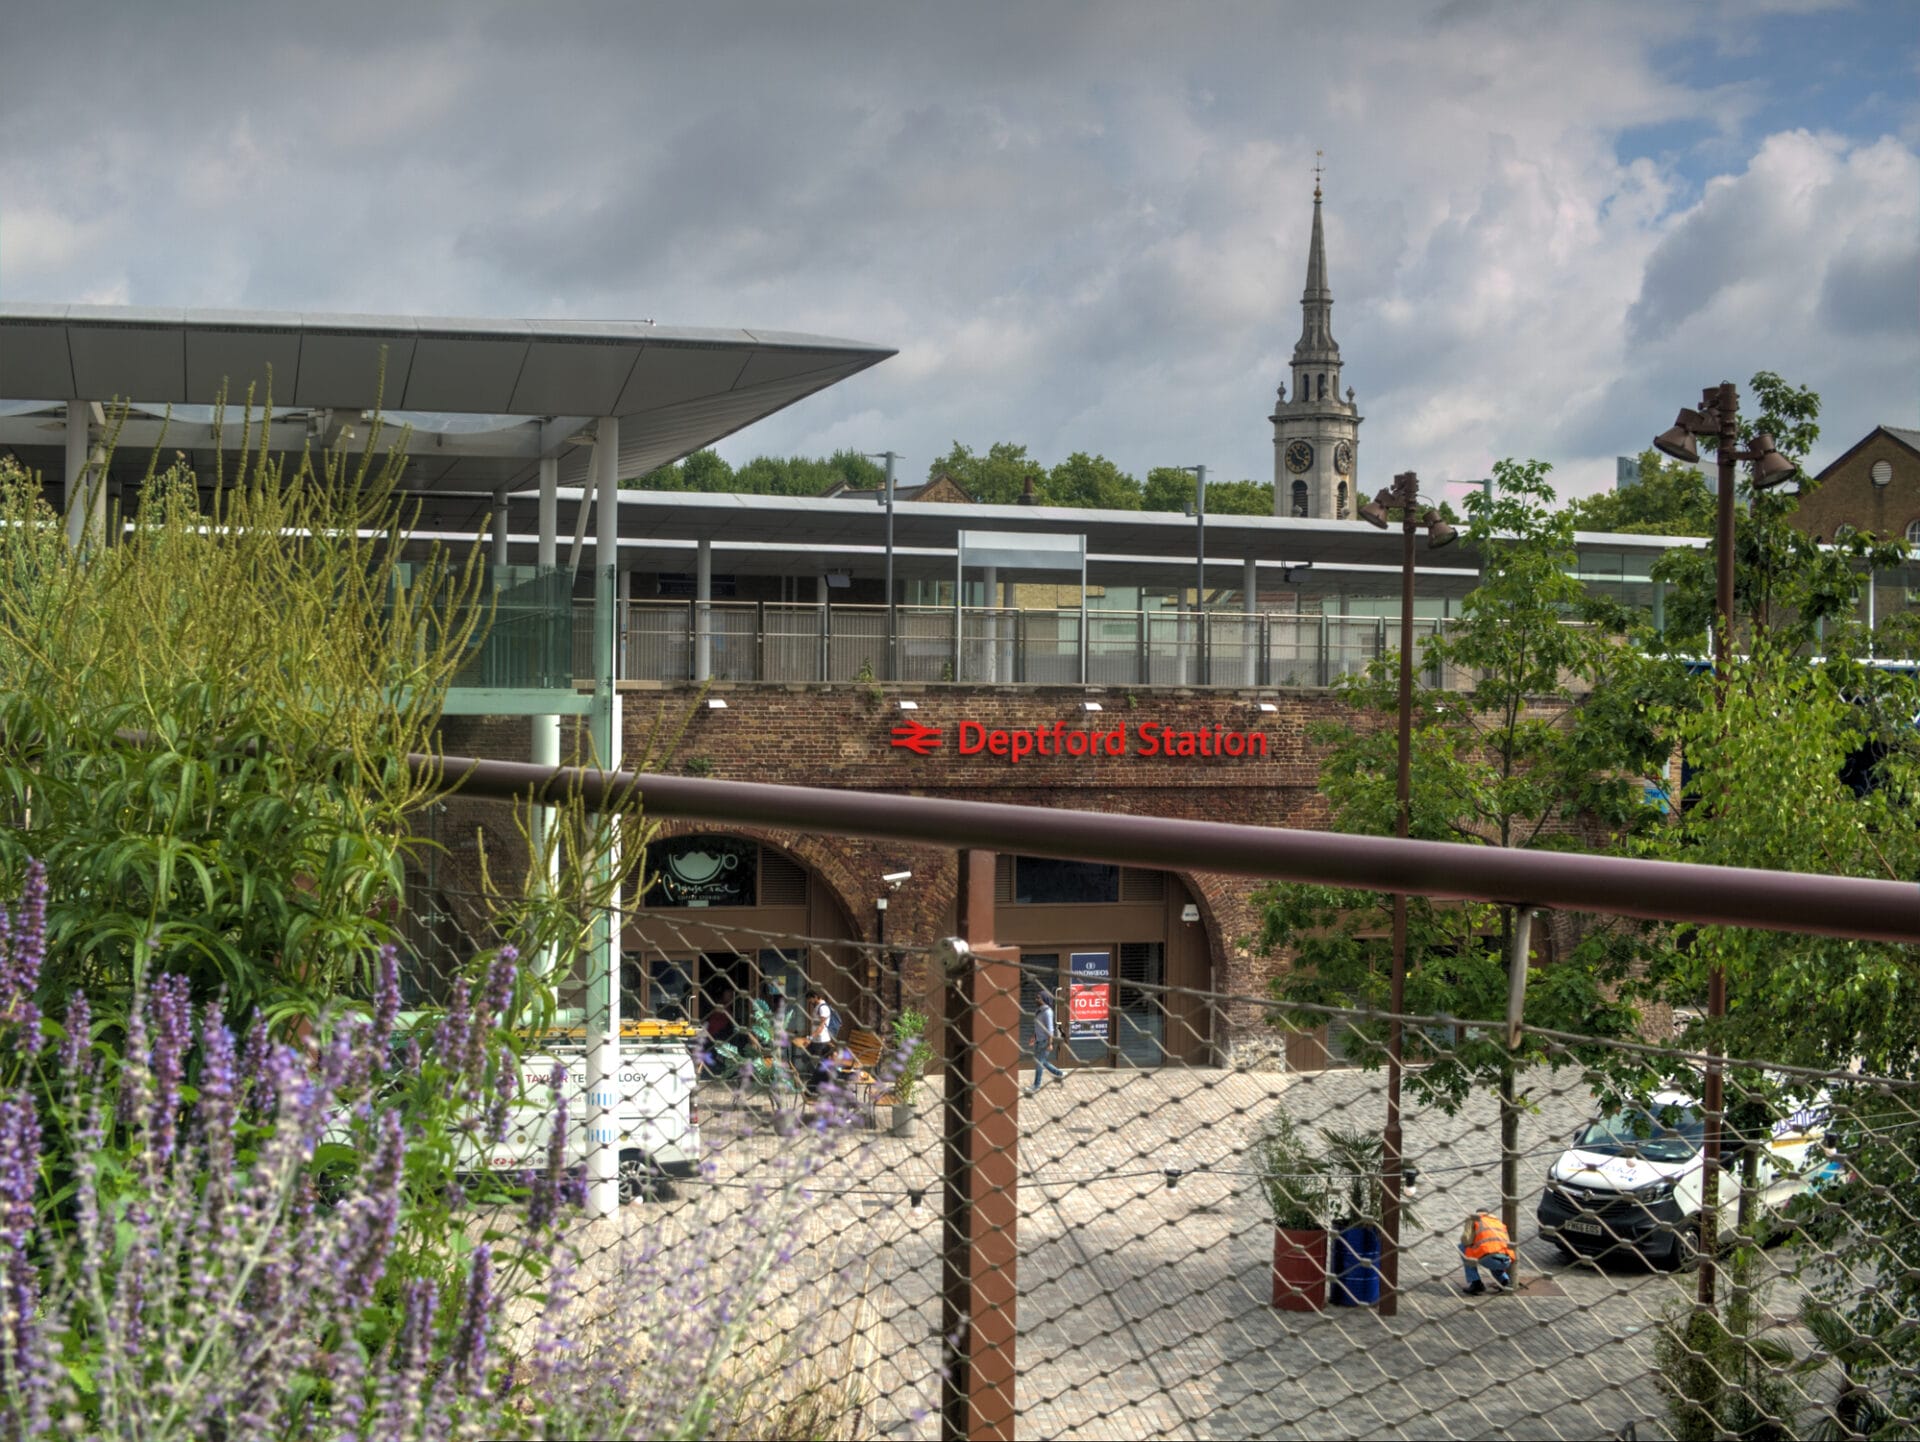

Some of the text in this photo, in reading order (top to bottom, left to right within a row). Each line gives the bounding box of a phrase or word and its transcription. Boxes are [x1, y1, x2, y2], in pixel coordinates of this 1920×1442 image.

[958, 720, 1268, 763] Deptford Station
[1075, 998, 1107, 1008] TO LET
